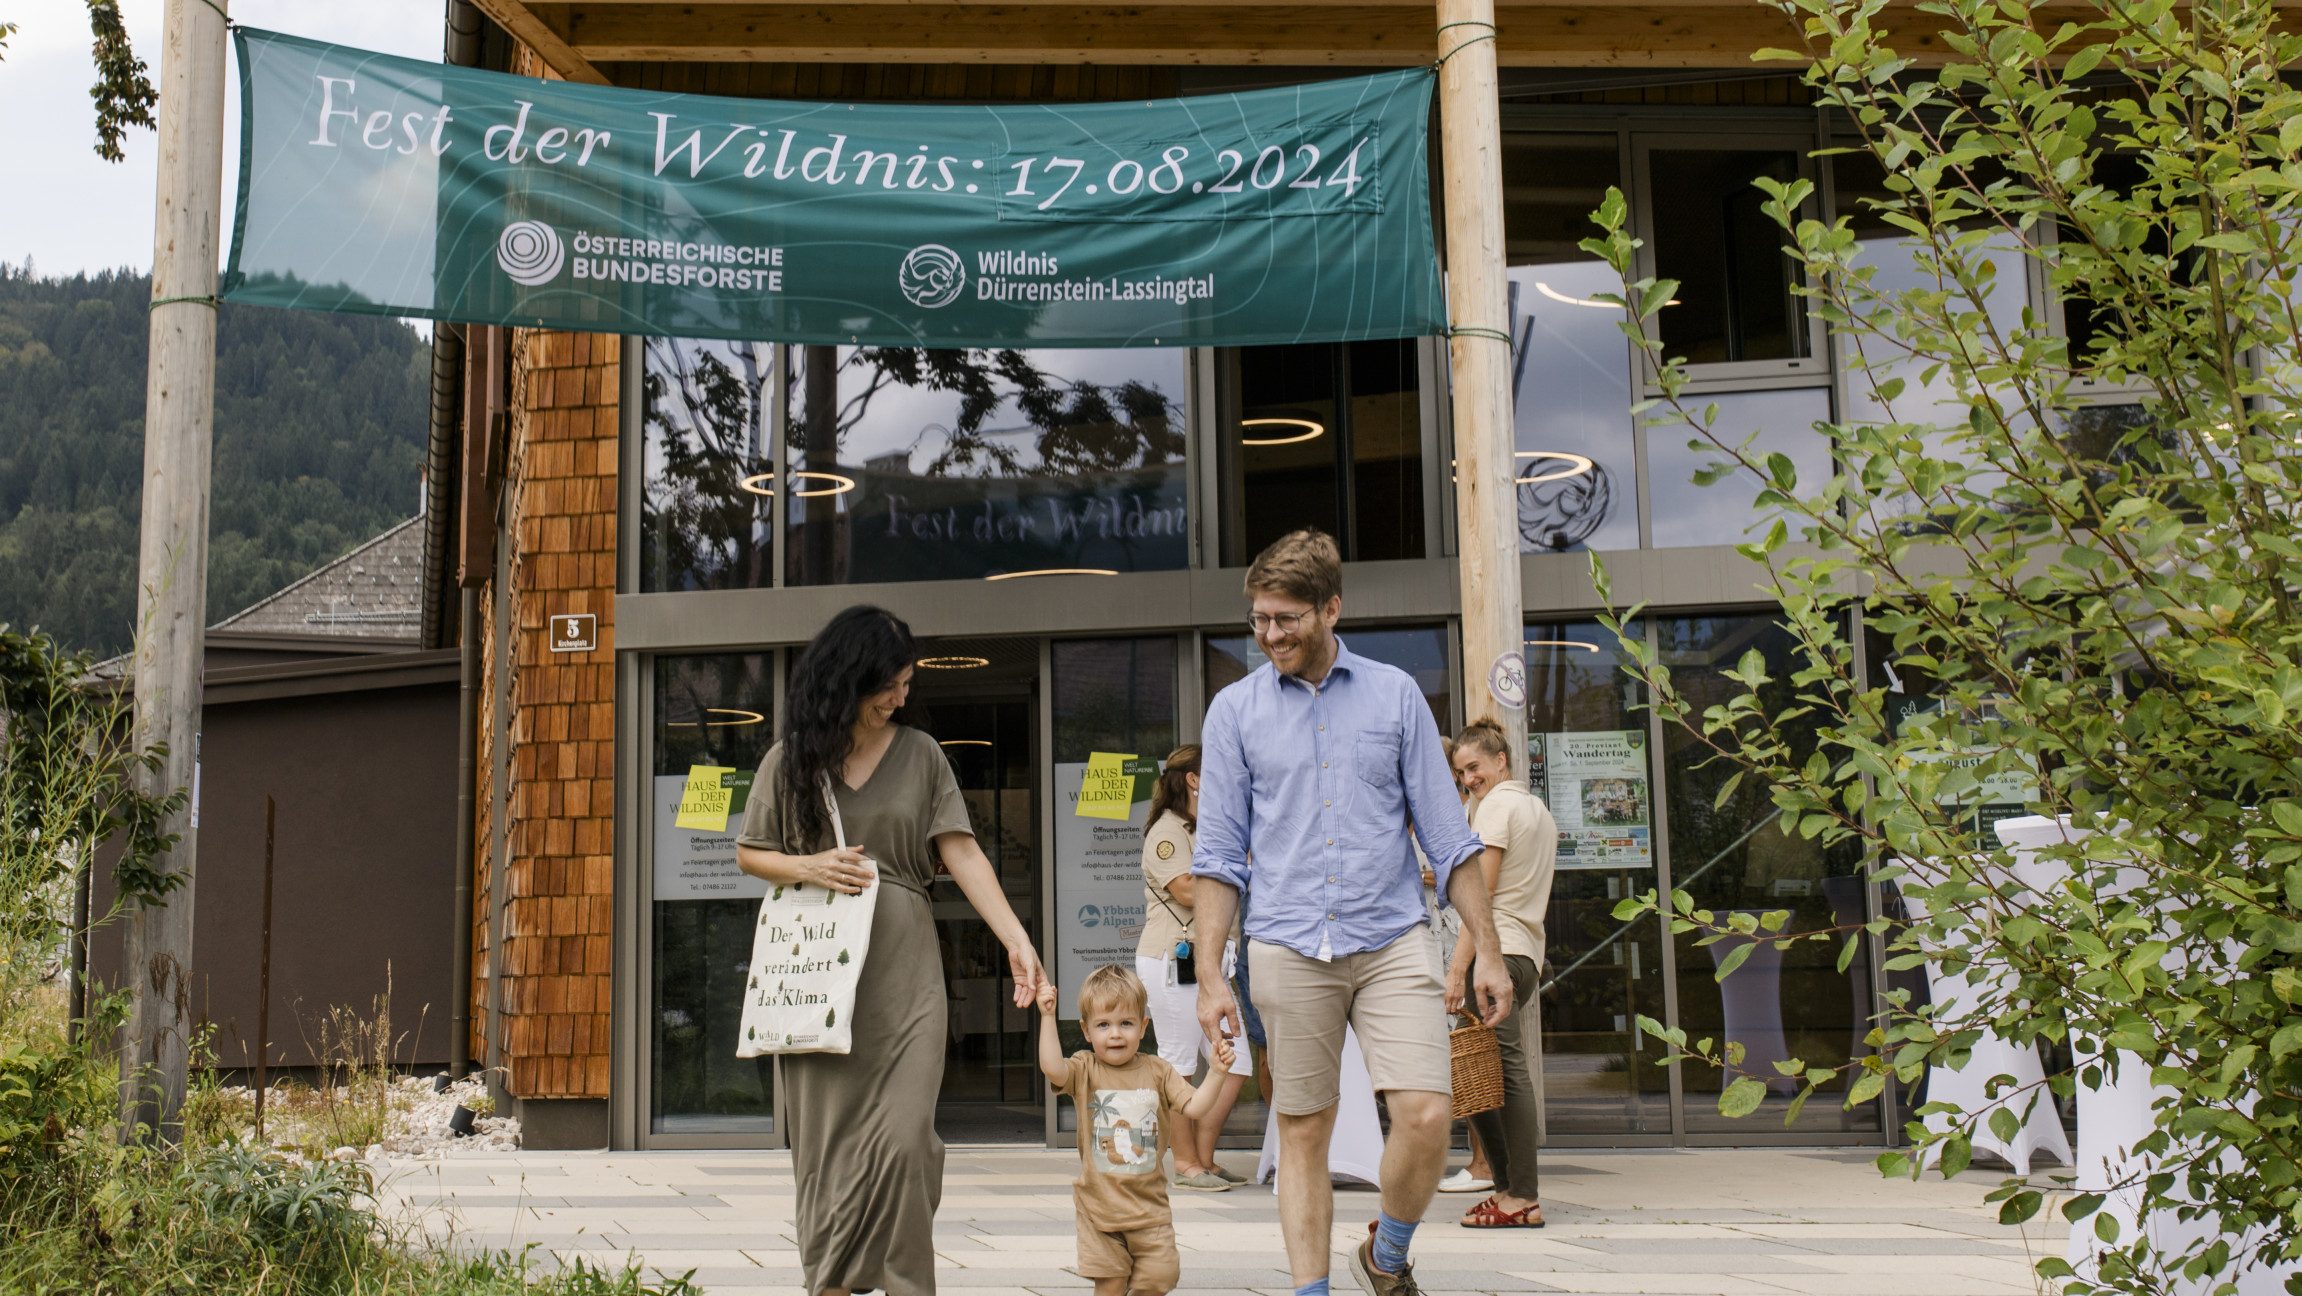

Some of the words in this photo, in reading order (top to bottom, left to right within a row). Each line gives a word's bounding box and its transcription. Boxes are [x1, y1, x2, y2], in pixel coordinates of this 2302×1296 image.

[309, 74, 453, 157] Fest
[484, 100, 610, 168] der
[647, 110, 984, 195] Wildnis:
[1005, 136, 1369, 210] 17.08.2024
[573, 230, 783, 267] ÖSTERREICHISCHE
[978, 250, 1058, 276] Wildnis
[572, 257, 783, 292] BUNDESFORSTE
[977, 273, 1214, 305] Dürrenstein-Lassingtal
[1047, 494, 1187, 542] Wildni
[567, 619, 580, 639] 5
[1563, 749, 1631, 758] Wandertag
[1081, 768, 1118, 779] HAUS
[682, 781, 716, 791] HAUS
[1101, 779, 1128, 790] DER
[700, 792, 726, 802] DER
[1069, 790, 1126, 802] WILDNIS
[670, 803, 724, 813] WILDNIS
[1093, 849, 1123, 857] Feiertagen
[1125, 848, 1143, 856] geöffn
[691, 858, 719, 866] Feiertagen
[720, 858, 736, 866] geöff
[1102, 904, 1145, 915] Ybbstal
[1103, 917, 1136, 928] Alpen
[769, 926, 793, 943] Der
[757, 990, 777, 1006] das
[782, 988, 829, 1006] Klima
